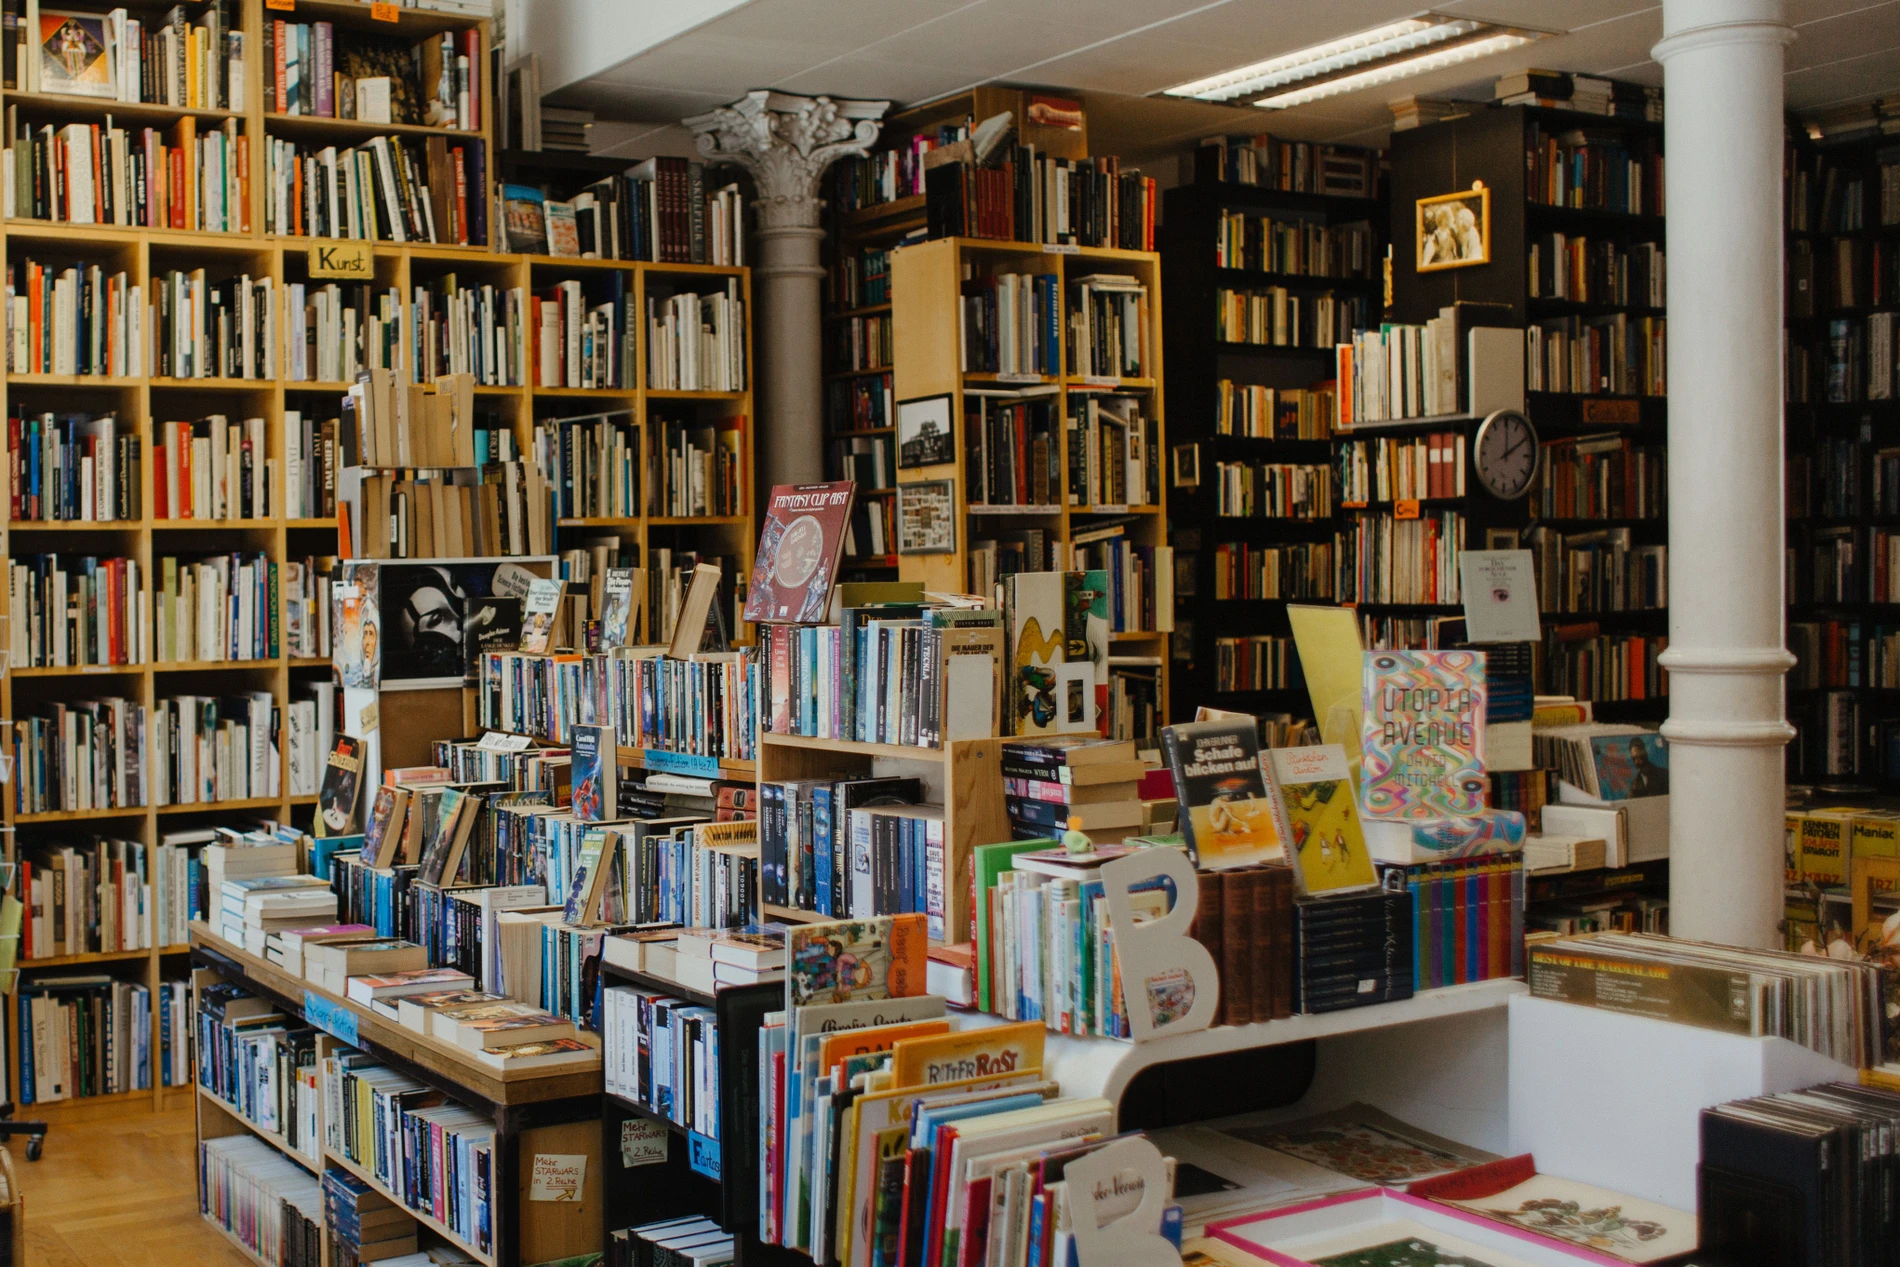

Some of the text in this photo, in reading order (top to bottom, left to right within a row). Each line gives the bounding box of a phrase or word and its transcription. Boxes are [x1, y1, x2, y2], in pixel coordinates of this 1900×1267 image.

[692, 179, 706, 240] SKULPTUR
[318, 246, 366, 272] Kunst
[489, 429, 498, 459] DÜRER
[324, 439, 334, 490] DAUMIER
[774, 491, 849, 509] FANTASY CLIP ART
[269, 566, 278, 646] DAVID HOCKNEY
[478, 630, 495, 641] Douglas
[951, 643, 994, 652] DIE MAUER DER
[922, 645, 931, 681] TECKLA
[1382, 687, 1471, 713] UTOPIA
[1382, 721, 1472, 746] AVENUE
[1196, 734, 1239, 748] JOHN BRUNNER
[1193, 747, 1243, 762] Schafe
[1406, 754, 1446, 768] DAVID
[1033, 768, 1049, 778] WYRM
[1185, 757, 1258, 777] blicken auf
[1394, 773, 1459, 788] MITCHELL
[1802, 820, 1840, 831] KENNETH
[1853, 825, 1895, 840] Maniac
[712, 830, 733, 842] VIKTOR
[1802, 828, 1840, 840] PATCHEN
[1802, 847, 1840, 858] ERWACHT
[1532, 952, 1559, 966] BEST
[1573, 957, 1594, 970] THE
[927, 1049, 1018, 1084] RITTER ROST
[622, 1121, 649, 1133] Mehr
[622, 1129, 667, 1143] STARWARS
[623, 1145, 665, 1158] in 2. Reihe
[534, 1156, 559, 1167] Mehr
[534, 1165, 579, 1177] STARWARS
[533, 1175, 578, 1186] in 2. Reihe
